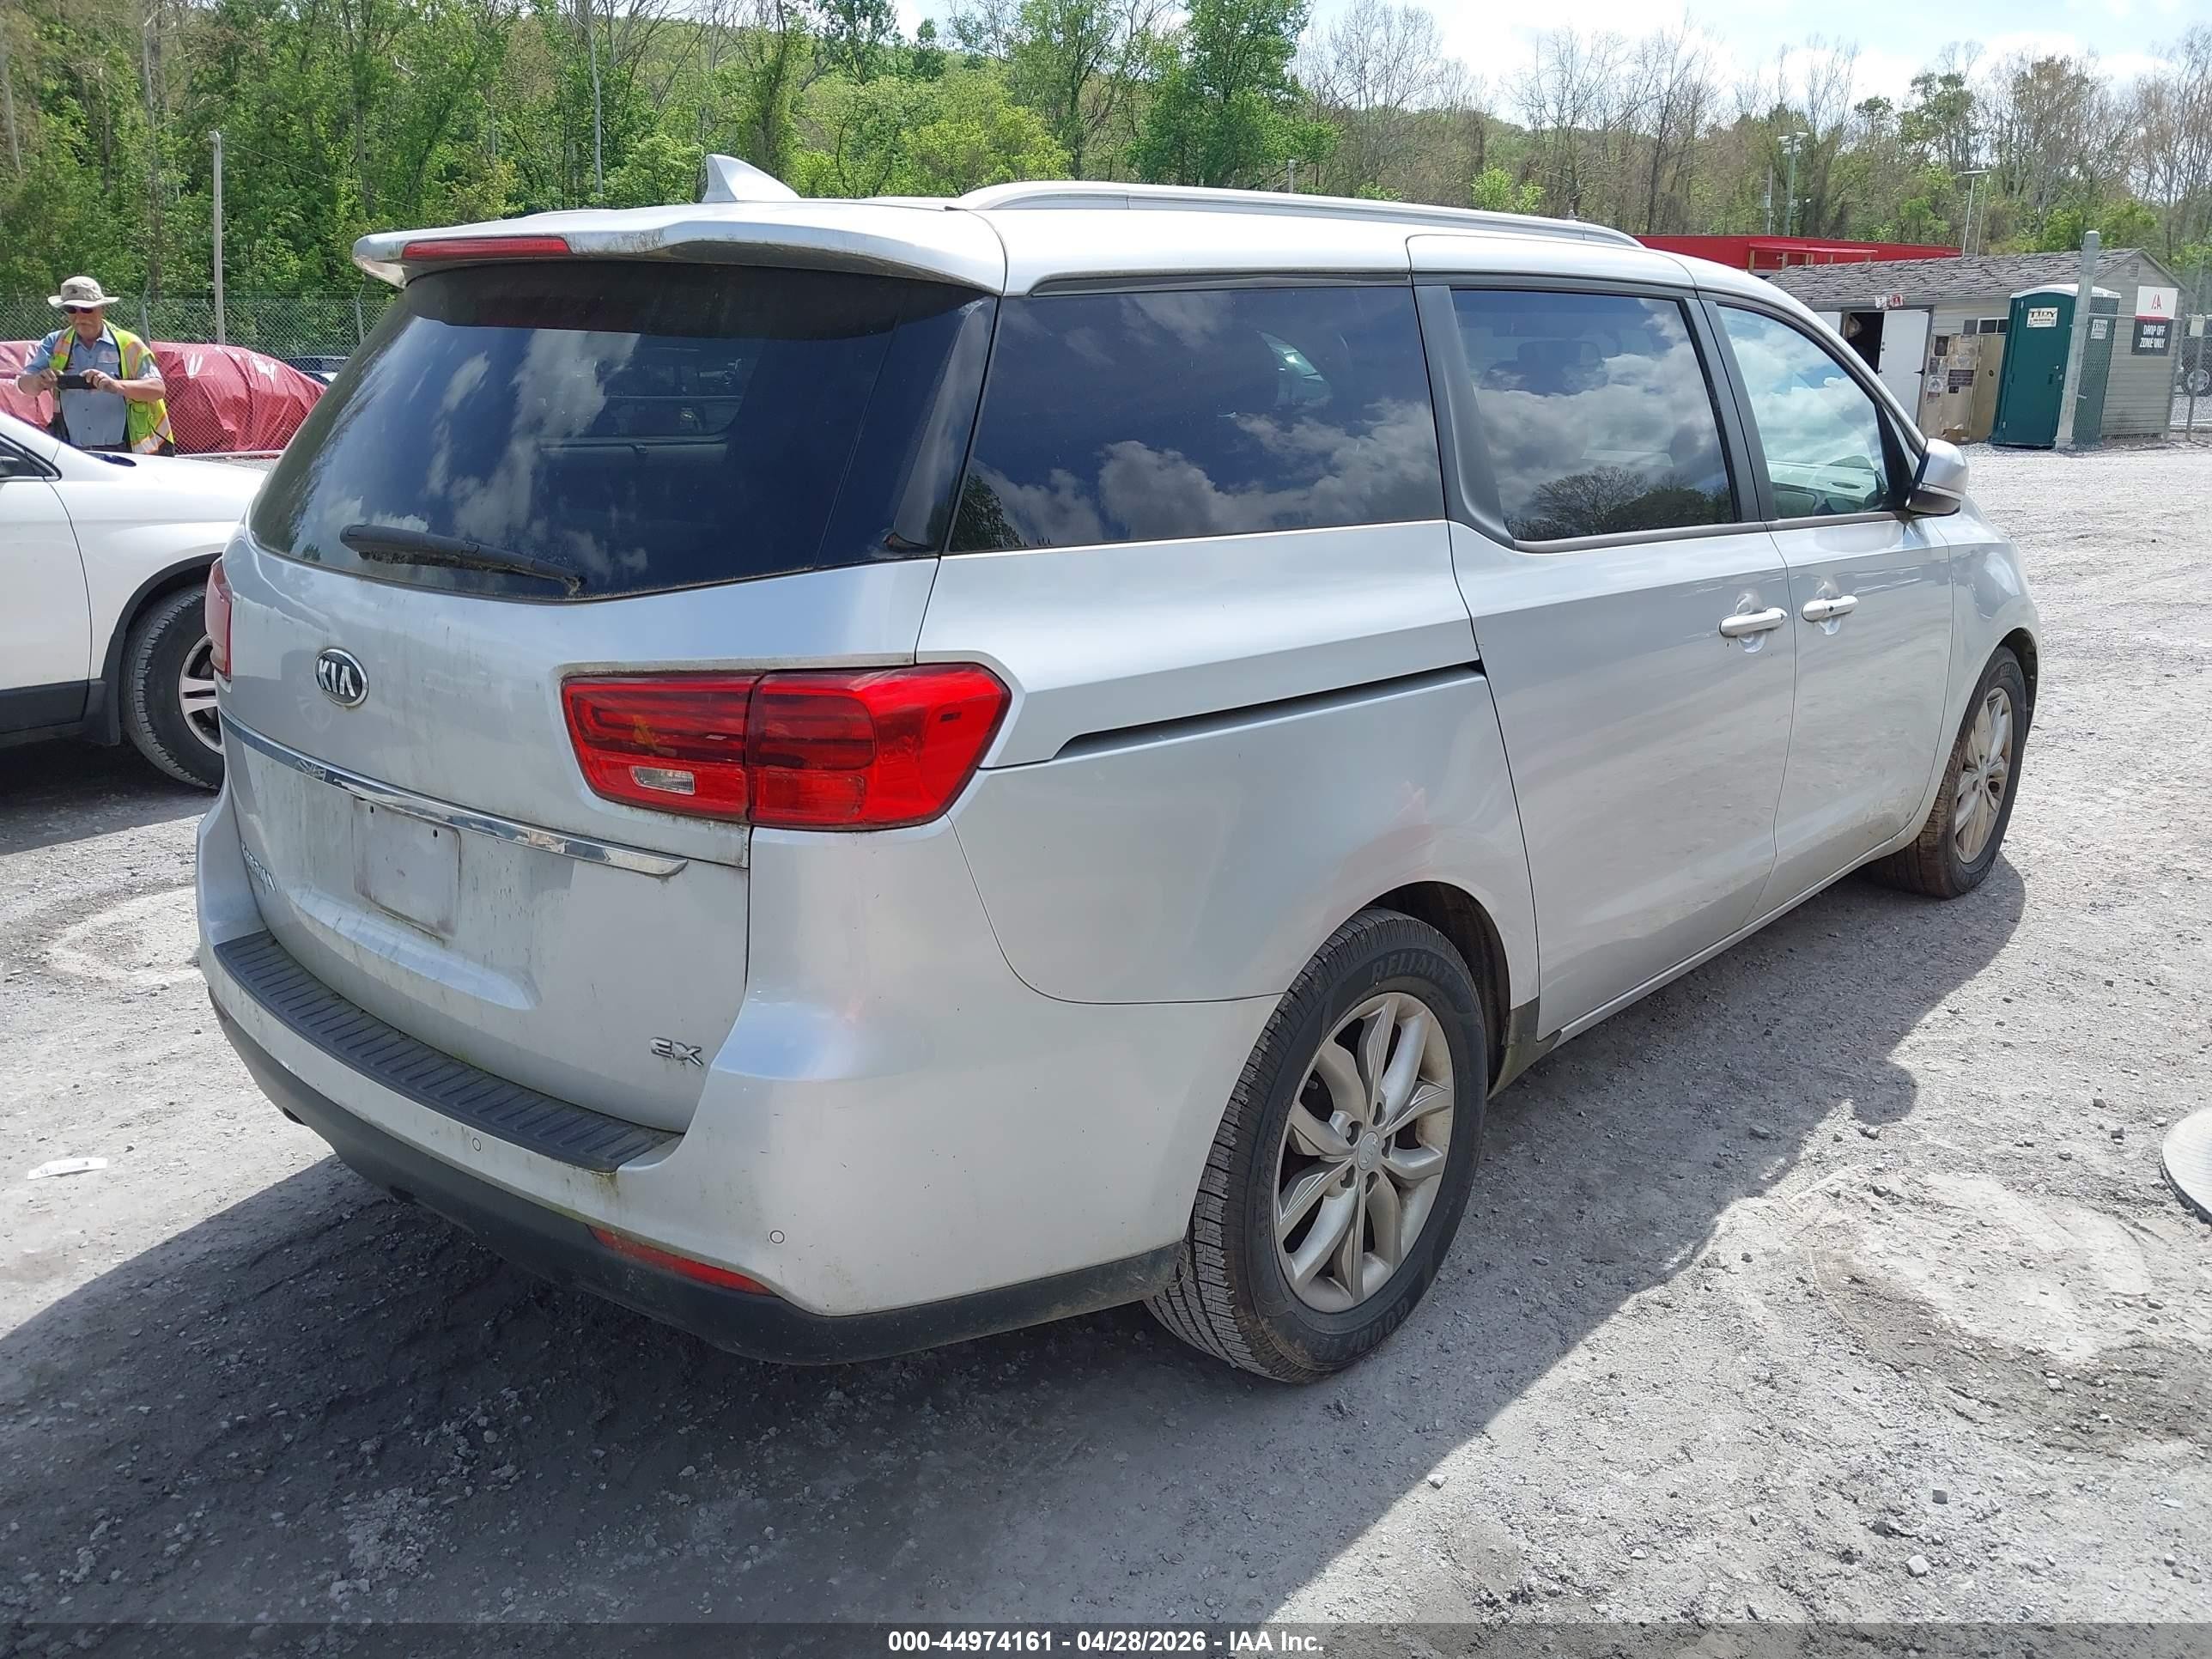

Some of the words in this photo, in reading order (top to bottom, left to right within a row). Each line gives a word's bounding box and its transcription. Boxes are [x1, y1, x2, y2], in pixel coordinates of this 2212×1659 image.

[2143, 325, 2157, 336] DROP
[2157, 325, 2166, 336] OFF
[2139, 337, 2154, 348] ZONE
[2154, 337, 2165, 348] ONLY
[318, 658, 356, 697] KIA
[649, 1036, 704, 1067] EX
